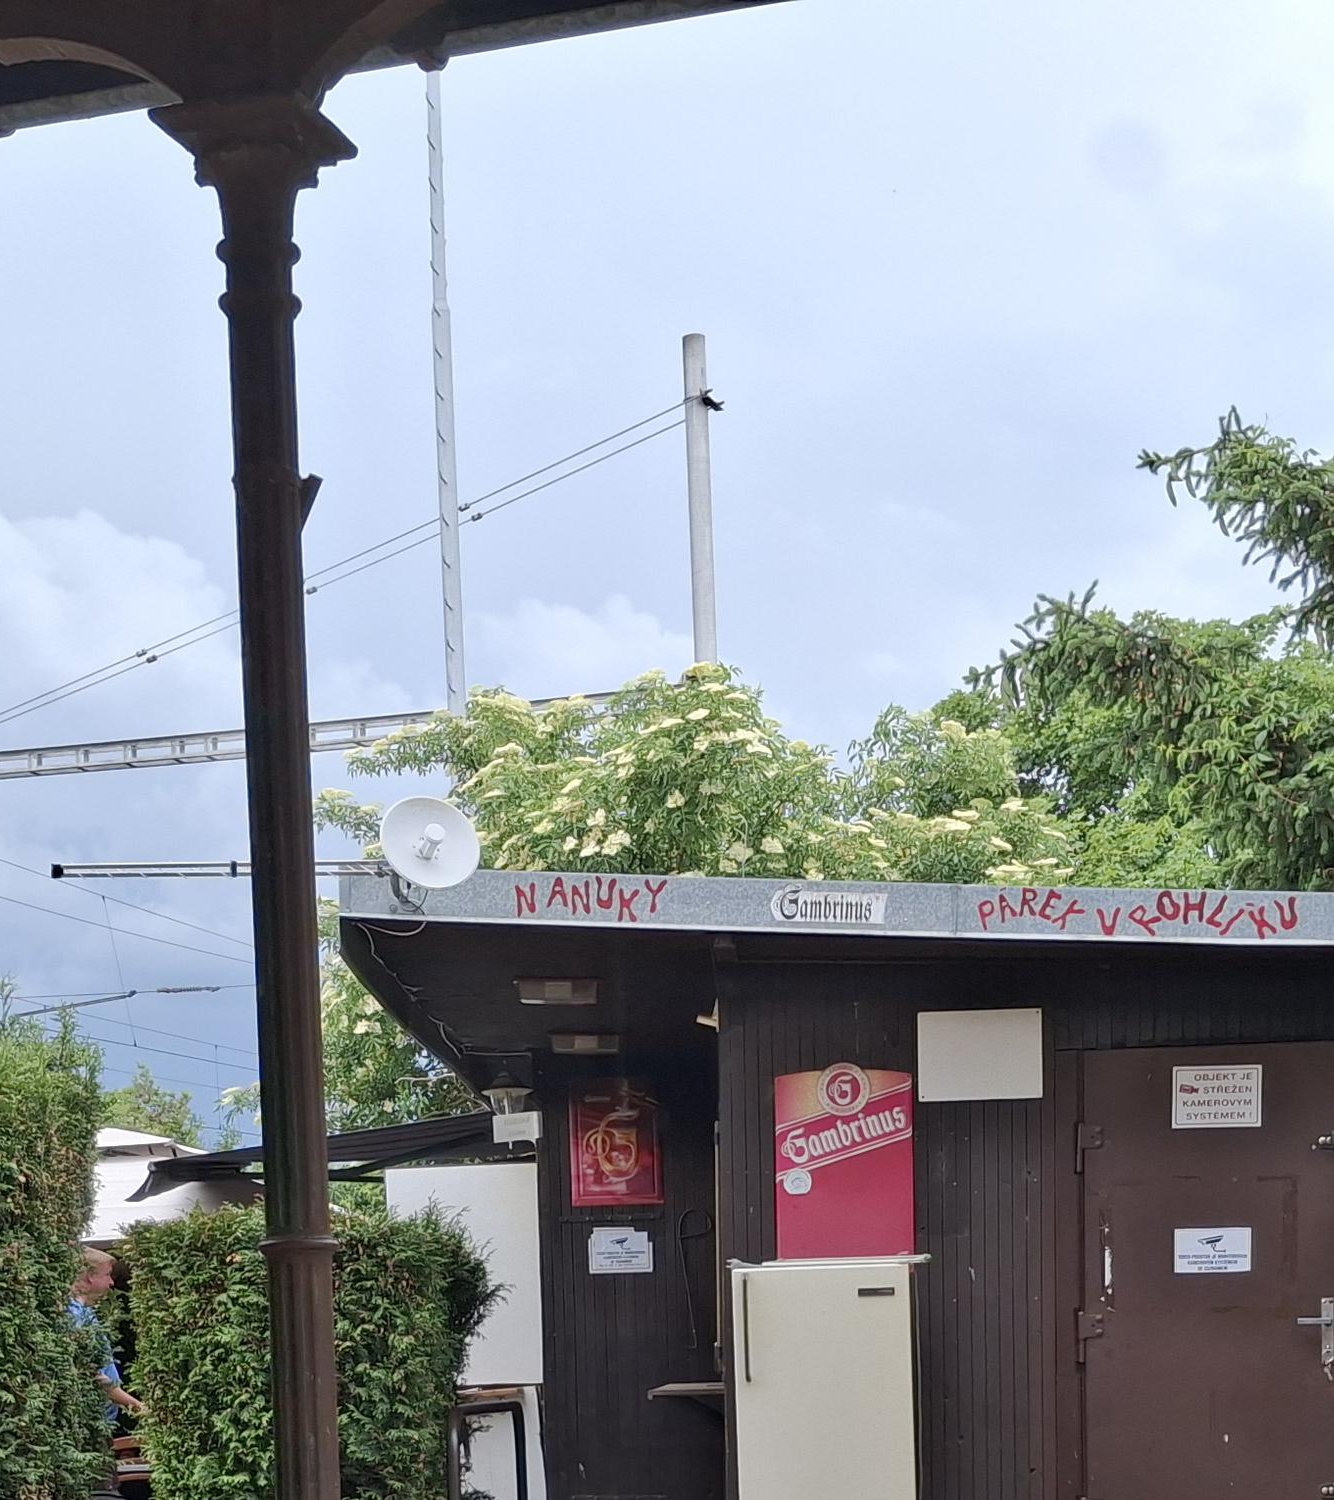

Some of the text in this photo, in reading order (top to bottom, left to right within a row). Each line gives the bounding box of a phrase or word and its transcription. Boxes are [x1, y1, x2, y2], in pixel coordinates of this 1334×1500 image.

[514, 875, 668, 922] NANUKY
[774, 883, 873, 922] Gambrinus
[1096, 907, 1122, 936] V
[1194, 1072, 1253, 1081] OBJEKT JE
[1202, 1084, 1253, 1094] STŘEŽEN
[781, 1106, 907, 1163] Gambrinus
